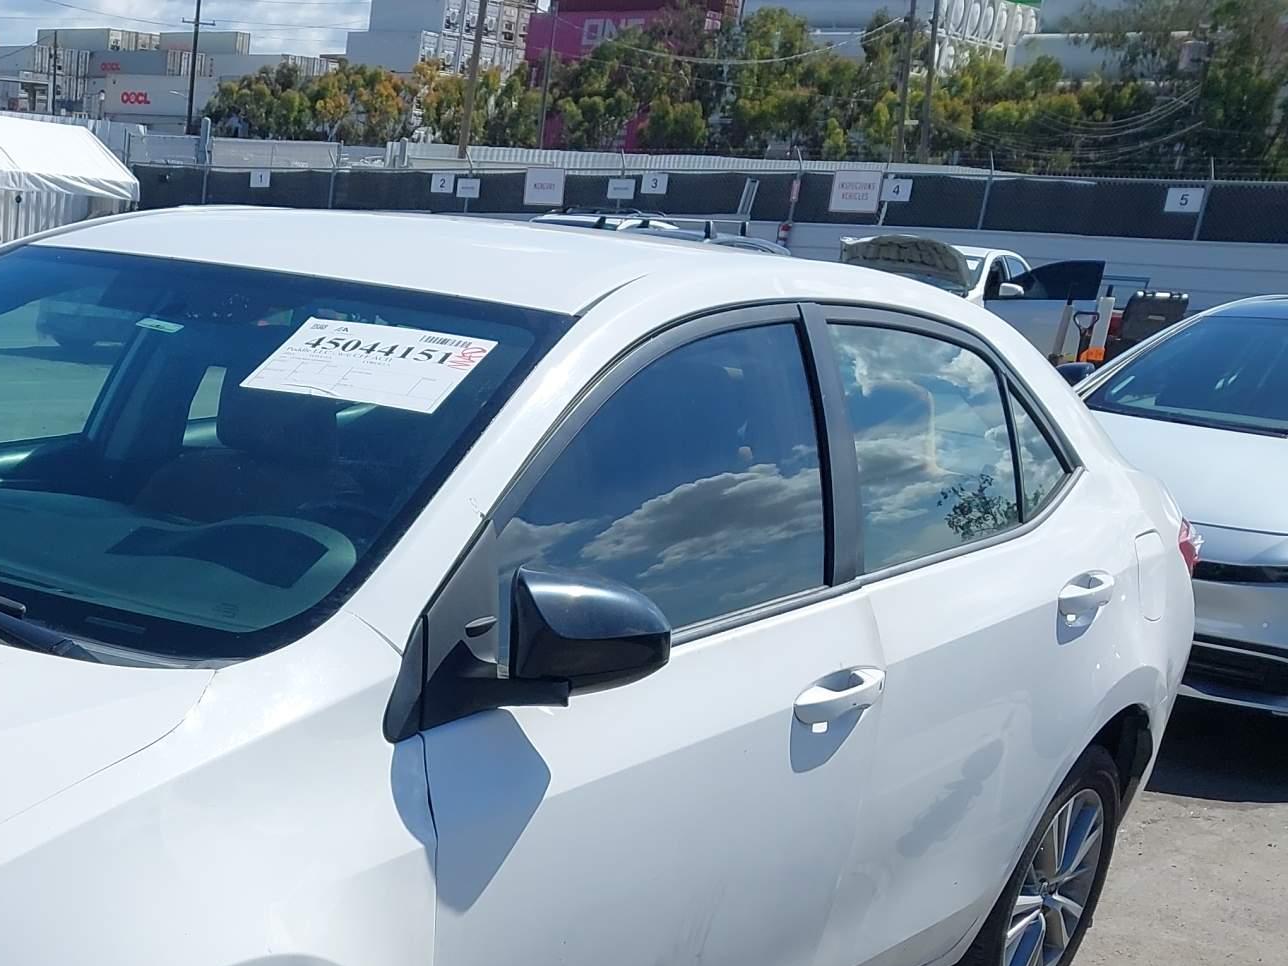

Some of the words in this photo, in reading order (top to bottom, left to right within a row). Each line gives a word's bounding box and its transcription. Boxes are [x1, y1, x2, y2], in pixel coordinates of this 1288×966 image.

[121, 91, 151, 105] OOCL
[439, 178, 446, 189] 2
[651, 178, 659, 189] 3
[892, 184, 900, 196] 4
[1179, 193, 1189, 206] 5
[304, 336, 453, 366] 45044151
